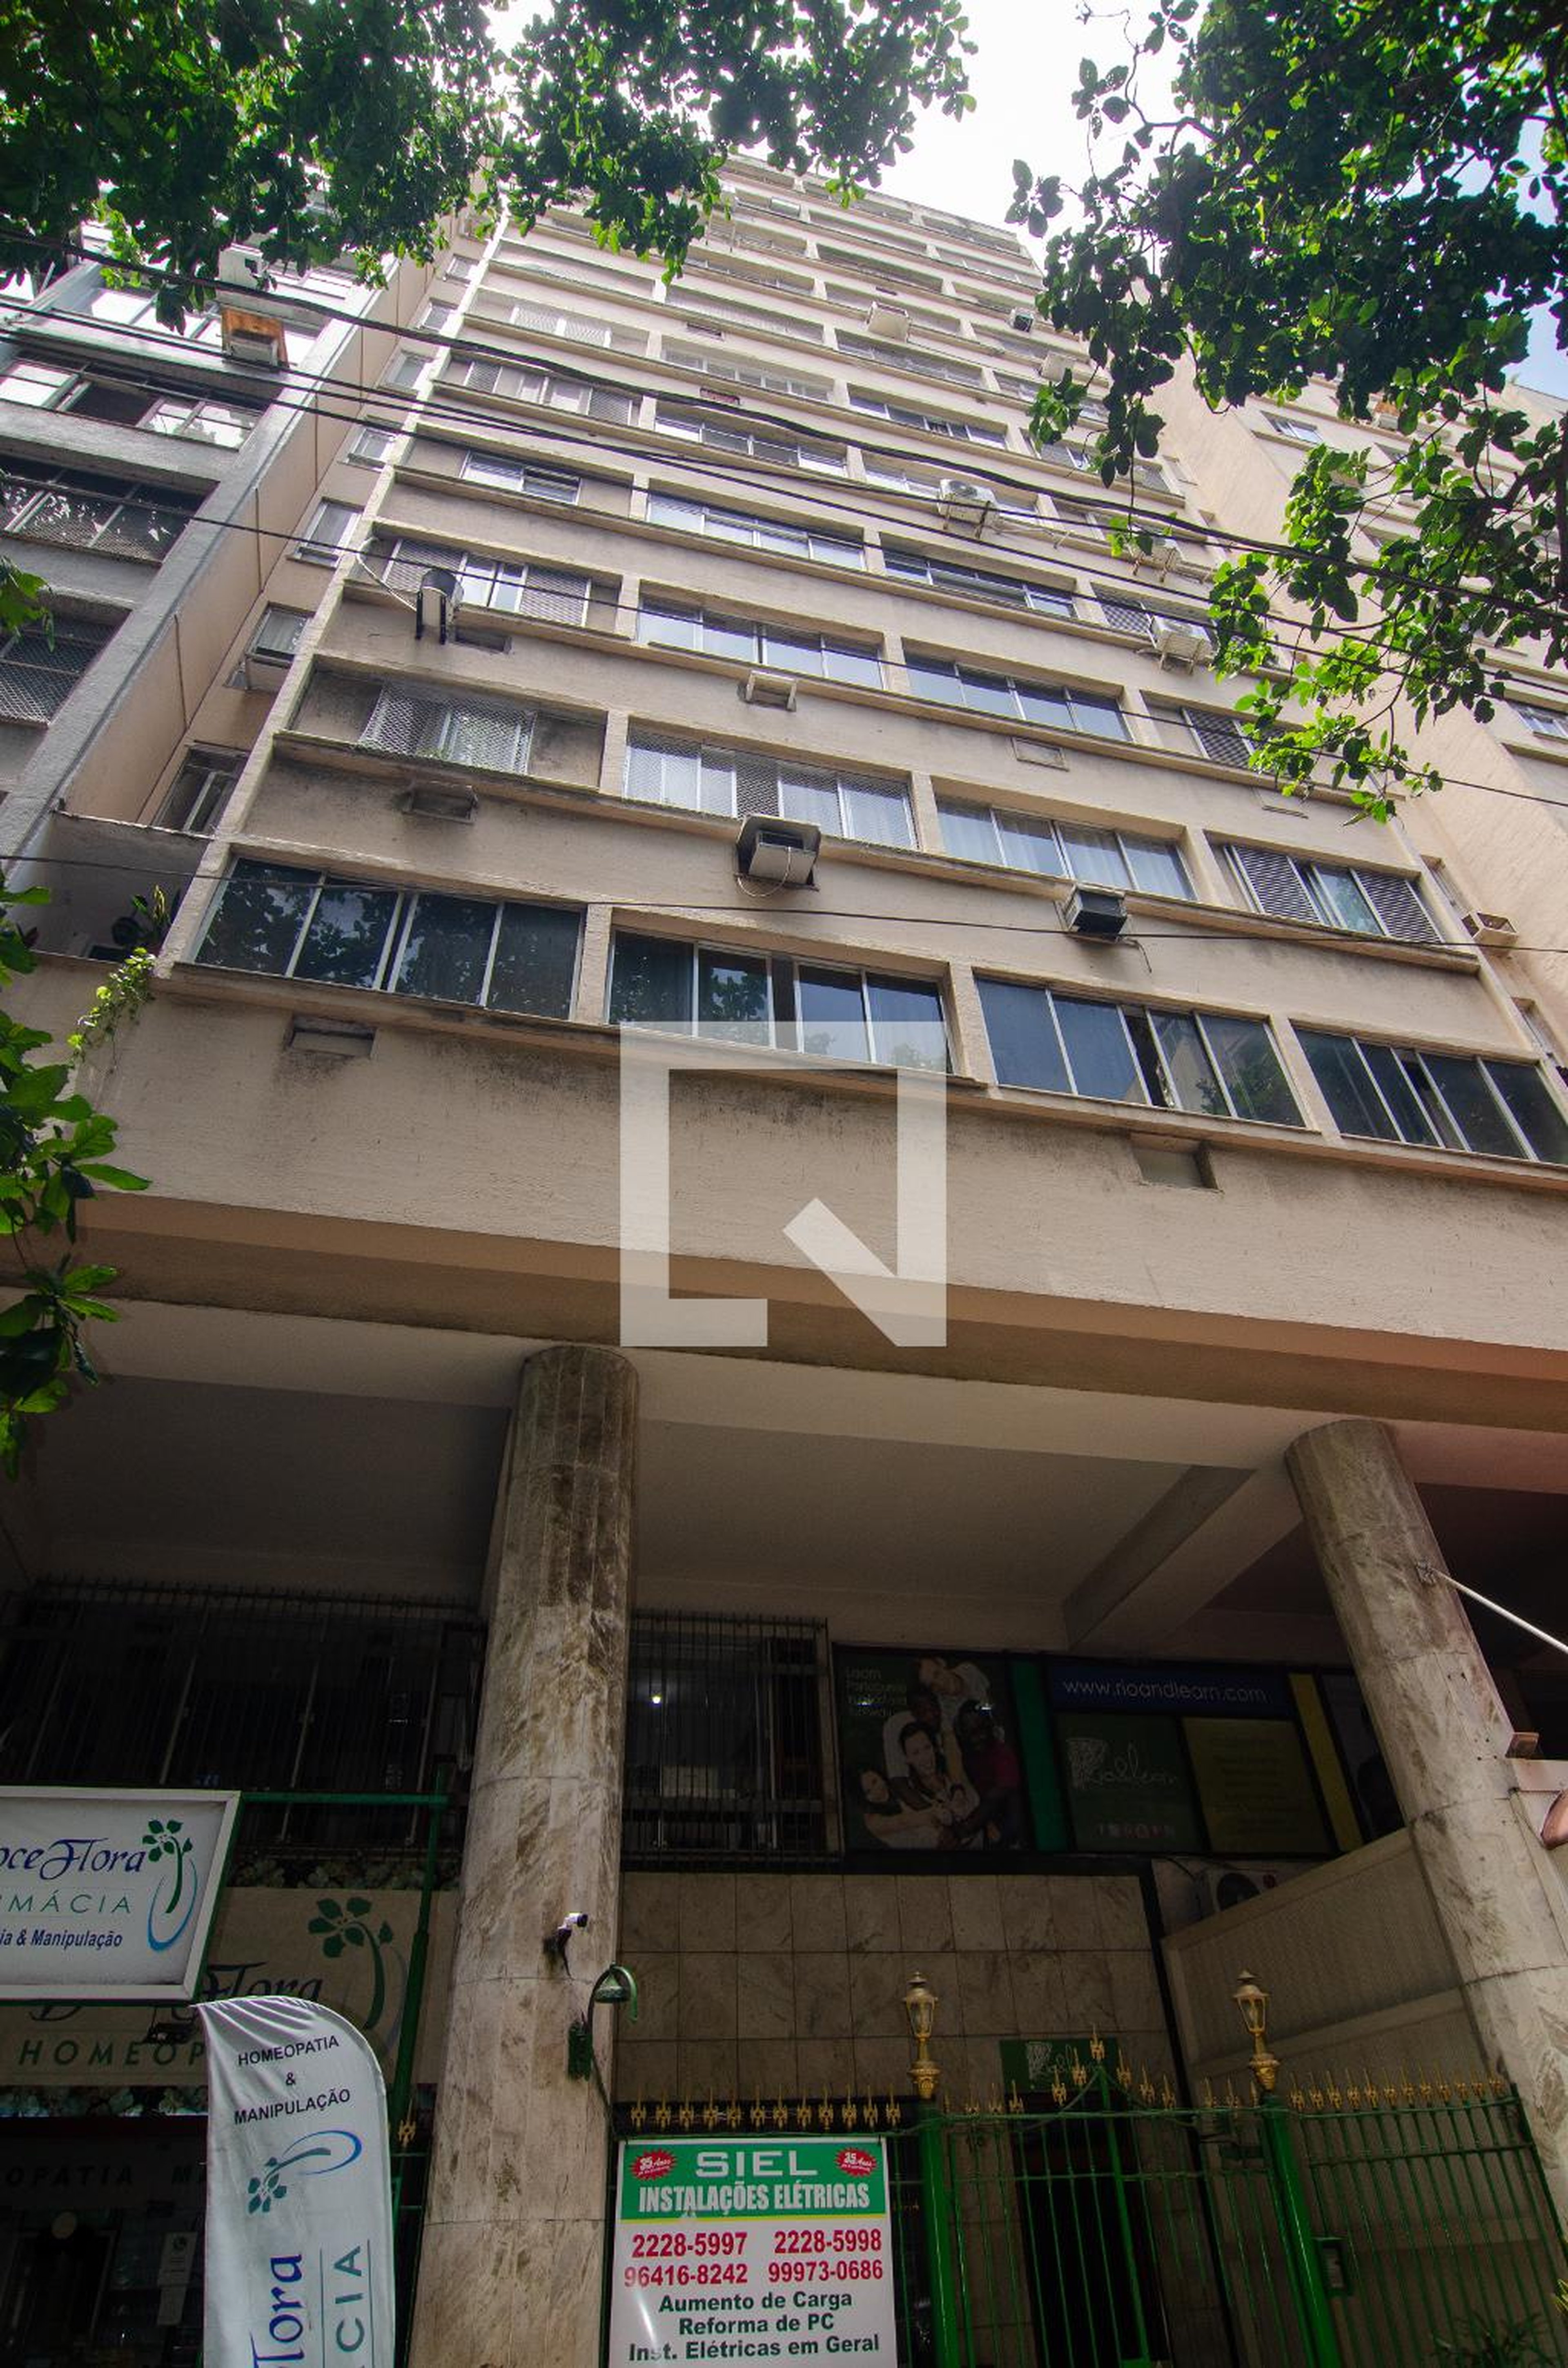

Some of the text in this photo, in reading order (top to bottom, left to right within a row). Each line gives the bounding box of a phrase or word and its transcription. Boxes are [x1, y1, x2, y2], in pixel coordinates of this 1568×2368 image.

[1063, 1677, 1267, 1703] www.rioandlearn.com
[0, 1890, 131, 1913] MÁCIA
[16, 1929, 27, 1946] &
[31, 1929, 123, 1951] Manipulação
[238, 2035, 339, 2065] HOMEOPATIA
[286, 2072, 296, 2085] &
[234, 2088, 350, 2125] MANIPULAÇÃO
[696, 2150, 818, 2177] SIEL
[639, 2179, 870, 2215] INSTALAÇÕES ELÉTRICAS
[632, 2228, 881, 2258] 2228-5997 2228-5998
[624, 2259, 883, 2287] 96416-8242 99973-0686
[659, 2291, 852, 2312] Aumento de Carga
[679, 2312, 834, 2335] Reforma de PC
[685, 2340, 781, 2359] Elétricas
[788, 2340, 818, 2355] em
[826, 2333, 879, 2353] Geral
